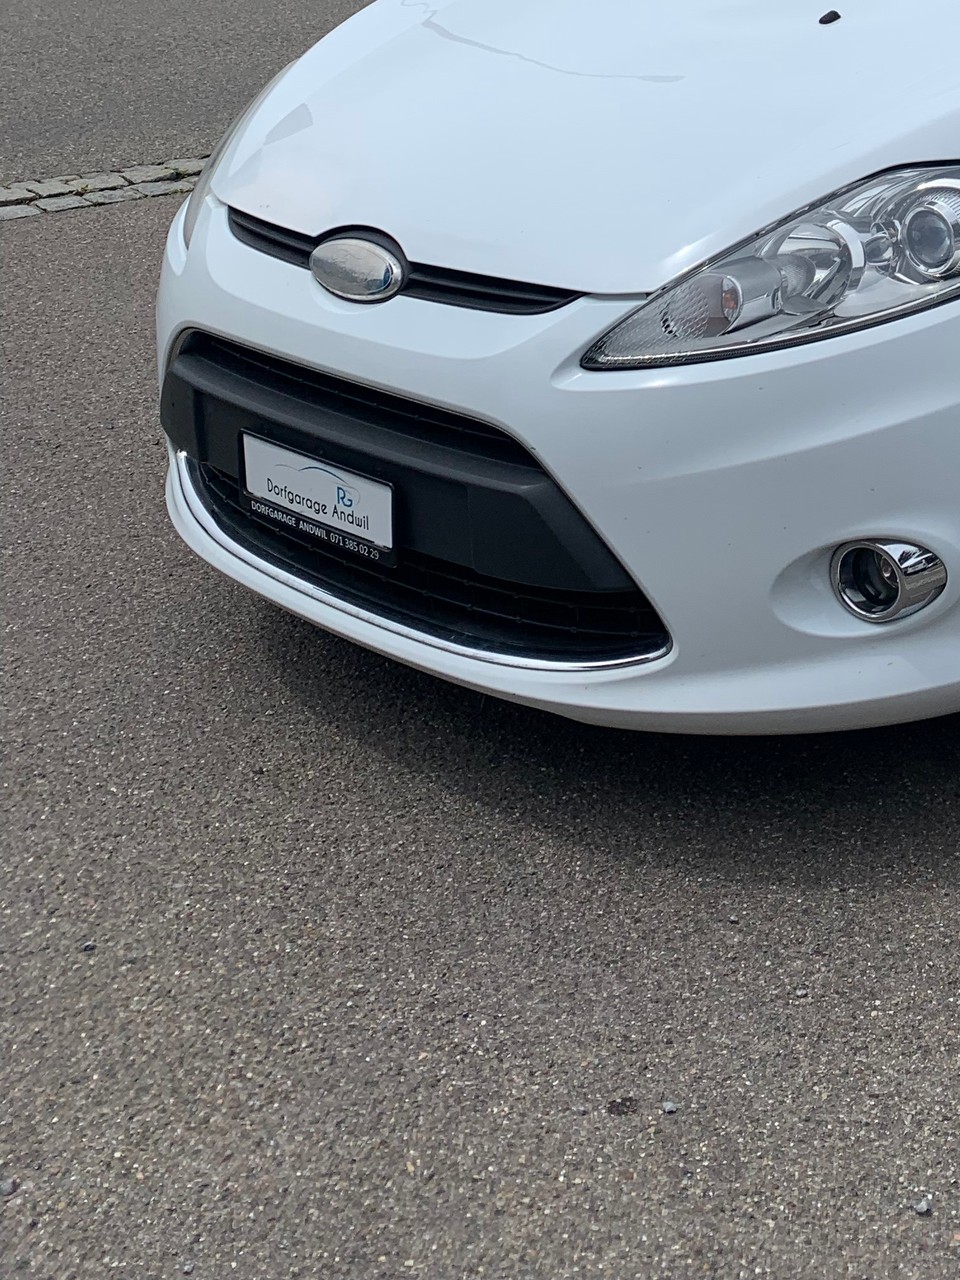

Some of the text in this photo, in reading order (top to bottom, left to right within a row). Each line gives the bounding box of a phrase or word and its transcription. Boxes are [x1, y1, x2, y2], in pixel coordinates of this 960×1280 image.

[251, 500, 380, 560] DORFGARAGE ANDWIL 071 385 02 29
[267, 478, 369, 530] Dorfgarage Andwil
